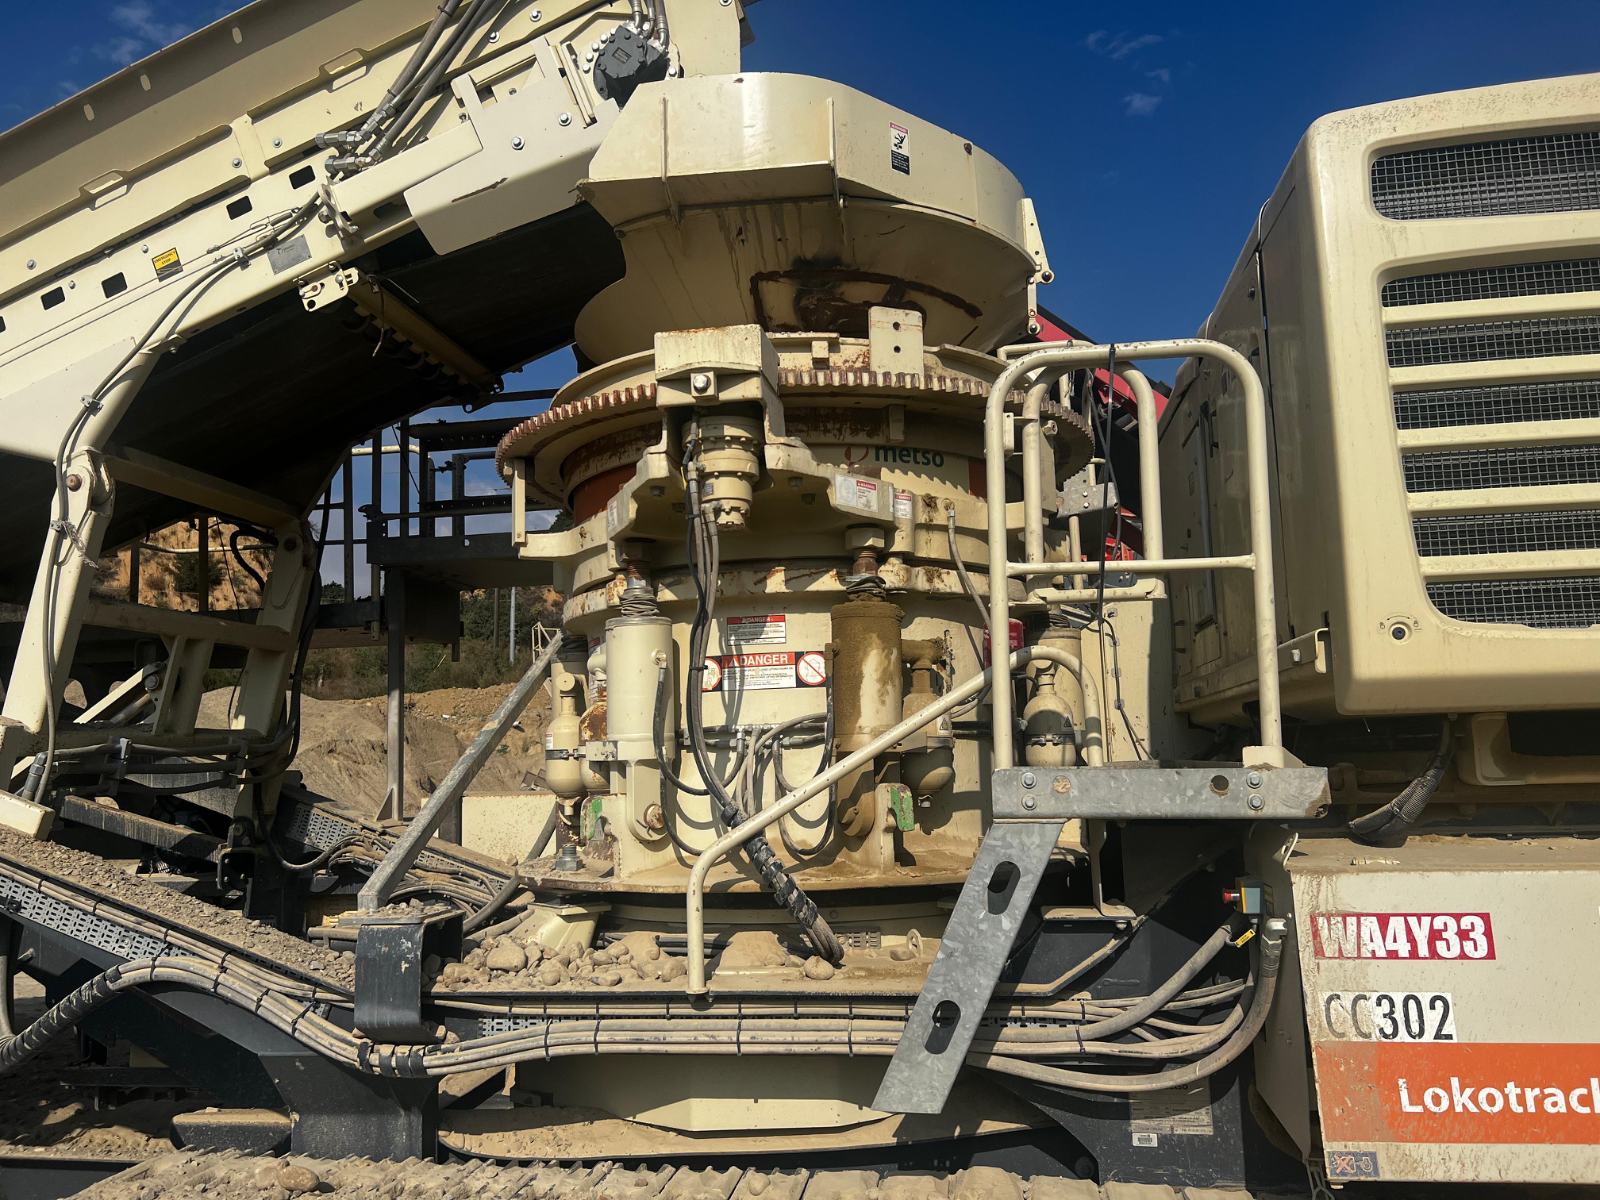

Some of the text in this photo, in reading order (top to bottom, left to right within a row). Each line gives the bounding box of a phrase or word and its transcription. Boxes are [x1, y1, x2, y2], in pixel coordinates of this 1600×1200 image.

[874, 445, 945, 468] metso
[740, 654, 788, 666] DANGER
[1316, 914, 1489, 959] WA4Y33
[1324, 994, 1454, 1041] CC302
